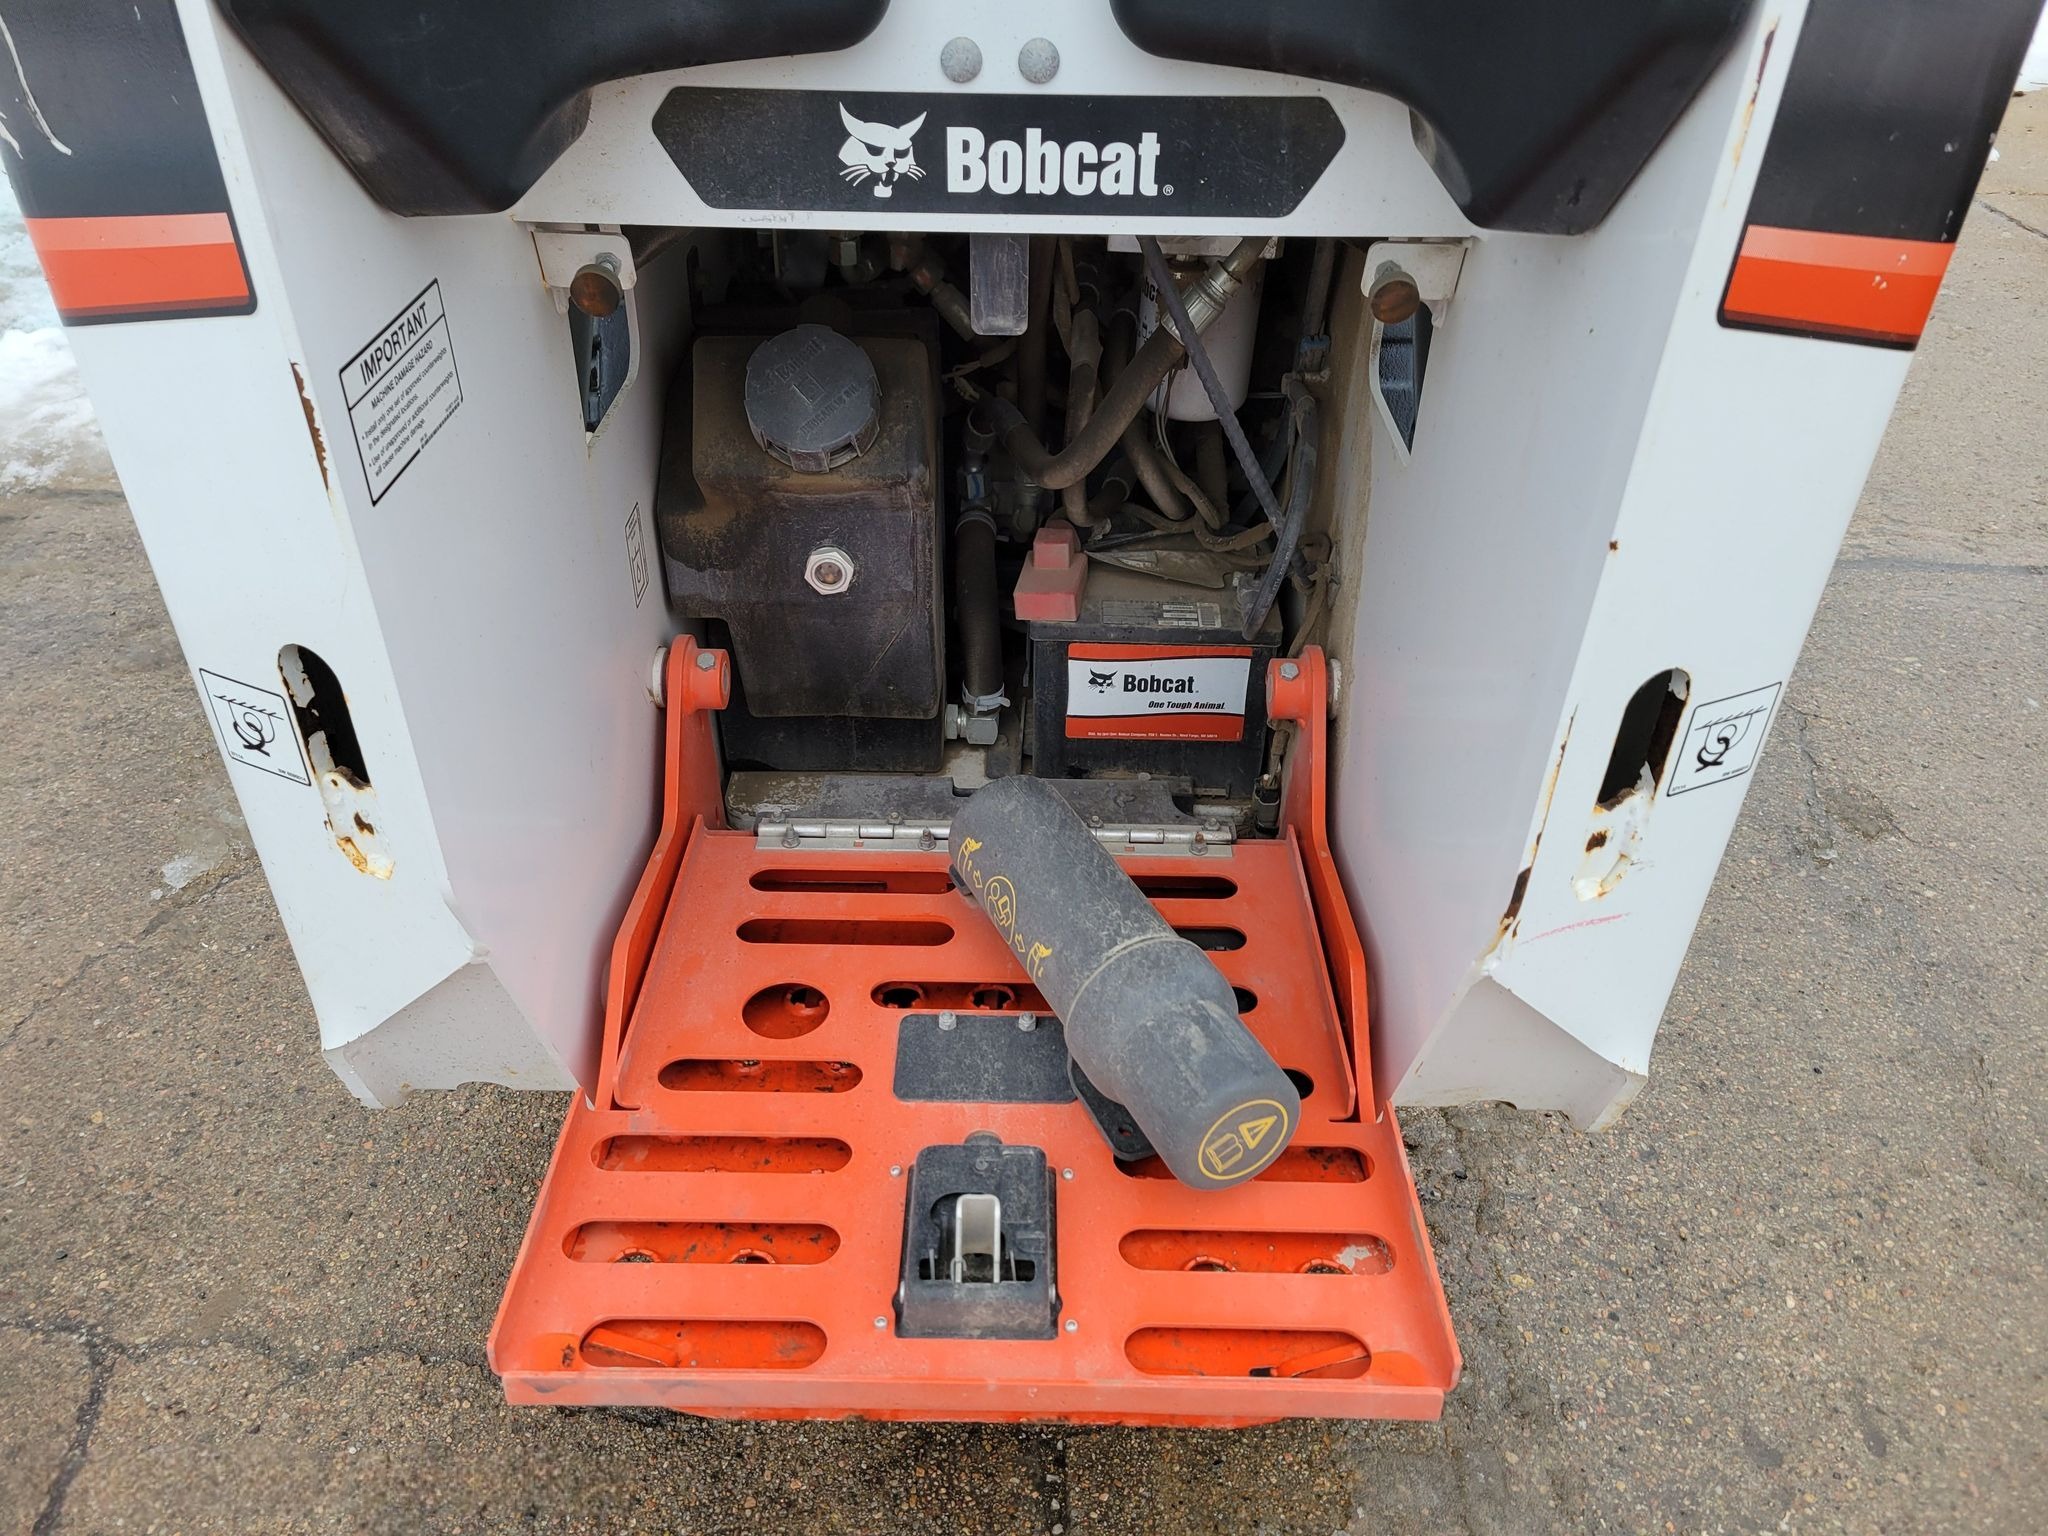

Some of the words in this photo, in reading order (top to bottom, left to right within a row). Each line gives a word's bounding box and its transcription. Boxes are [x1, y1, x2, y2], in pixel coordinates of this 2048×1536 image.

[946, 126, 1160, 197] Bobcat
[361, 301, 428, 386] IMPORTANT
[370, 378, 394, 410] MACHINE
[393, 356, 415, 386] DAMAGE
[413, 337, 433, 365] HAZARD
[364, 420, 377, 439] Install
[377, 411, 385, 426] only
[404, 372, 422, 397] approved
[421, 345, 447, 379] counterweights
[379, 410, 401, 439] designated
[384, 421, 407, 452] unapproved
[411, 397, 428, 421] additional
[428, 369, 453, 403] counterweights
[382, 451, 394, 470] cause
[393, 433, 410, 456] machine
[409, 415, 425, 439] damage.
[1123, 674, 1194, 693] Bobcat
[1166, 701, 1192, 709] Tough
